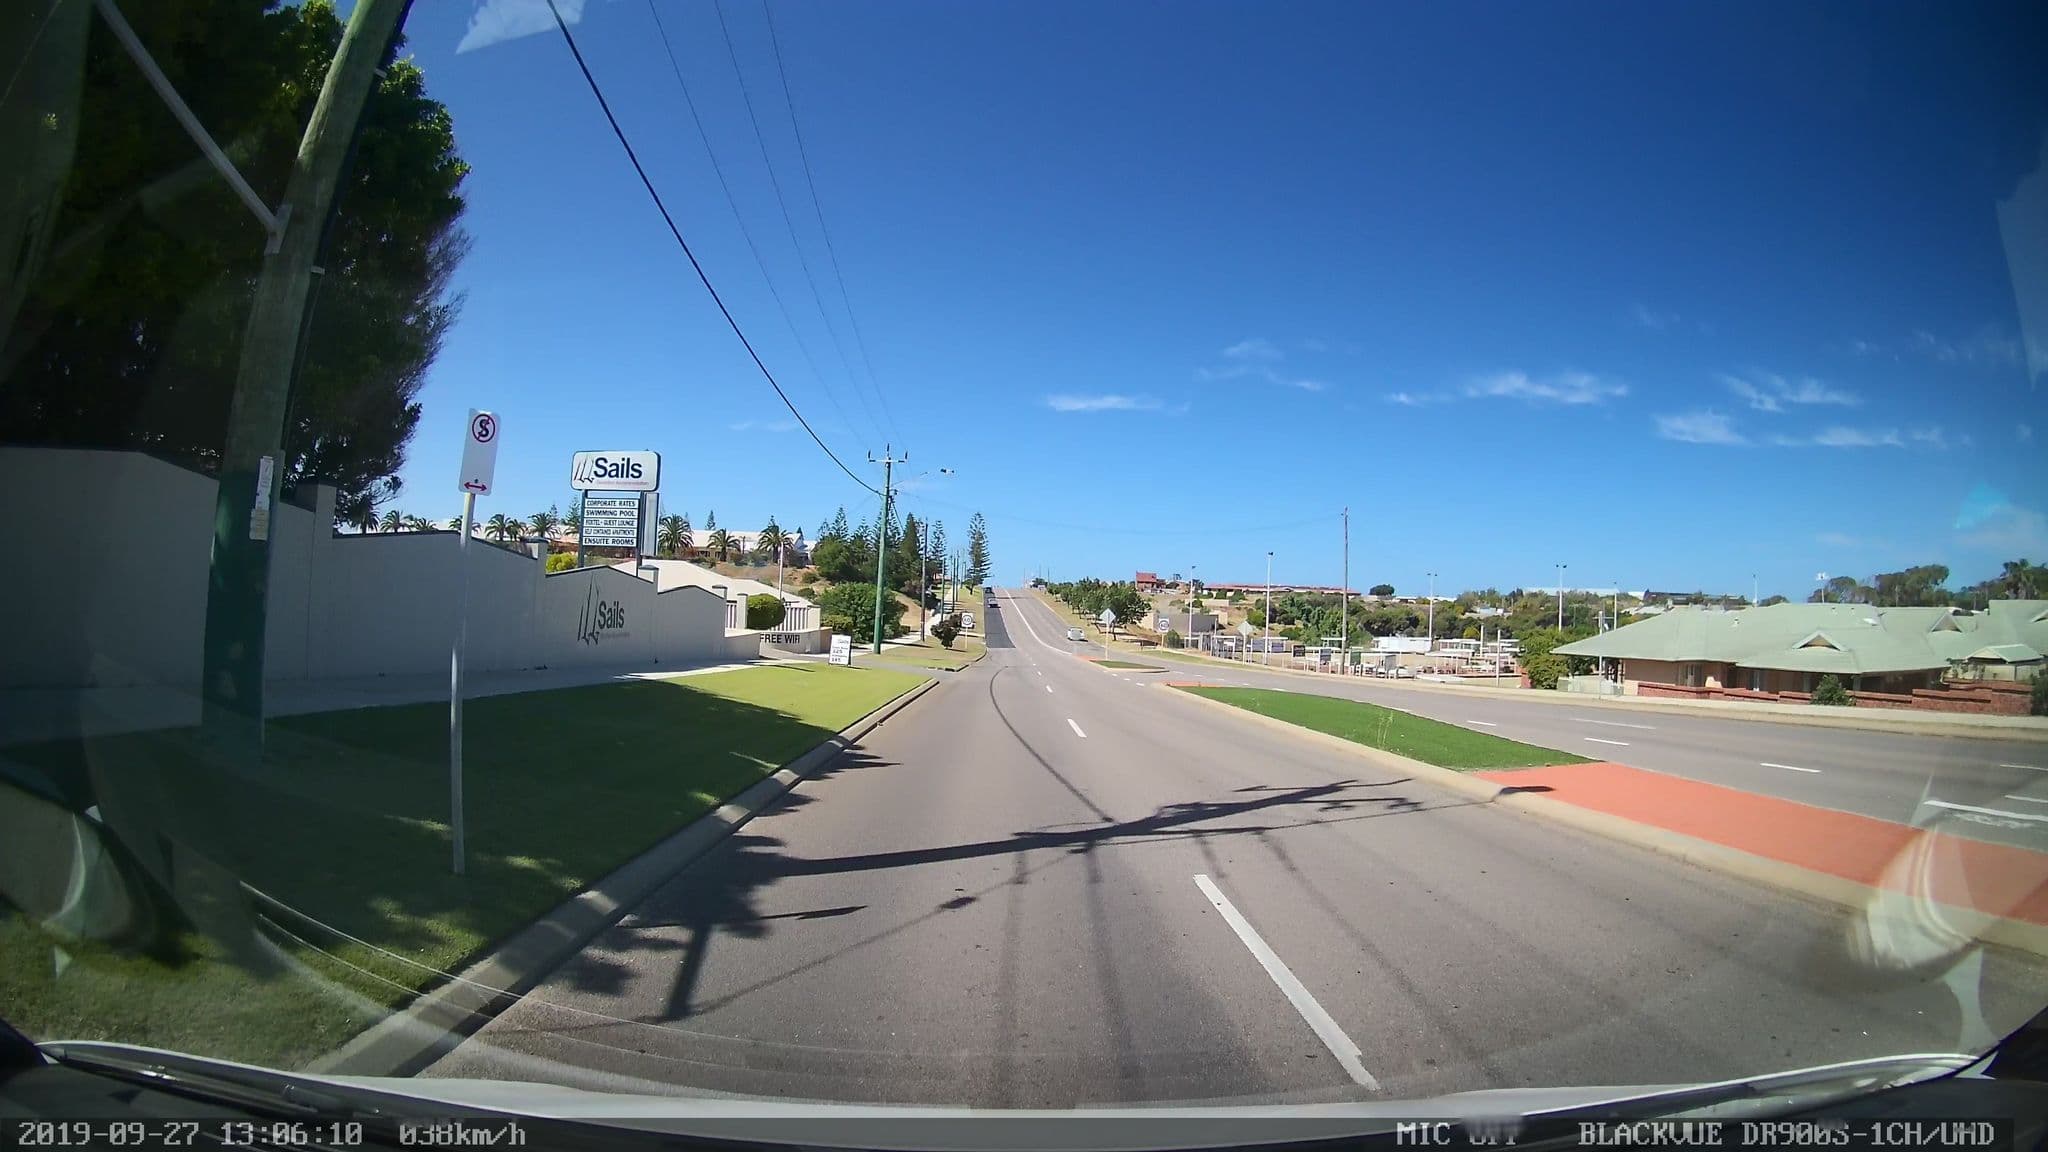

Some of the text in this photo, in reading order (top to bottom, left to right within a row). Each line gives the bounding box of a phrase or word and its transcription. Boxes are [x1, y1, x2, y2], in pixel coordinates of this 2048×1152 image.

[594, 457, 643, 479] Sails
[584, 537, 635, 546] ENSUITE ROOMS
[598, 600, 625, 630] Sails
[760, 633, 783, 644] FREE
